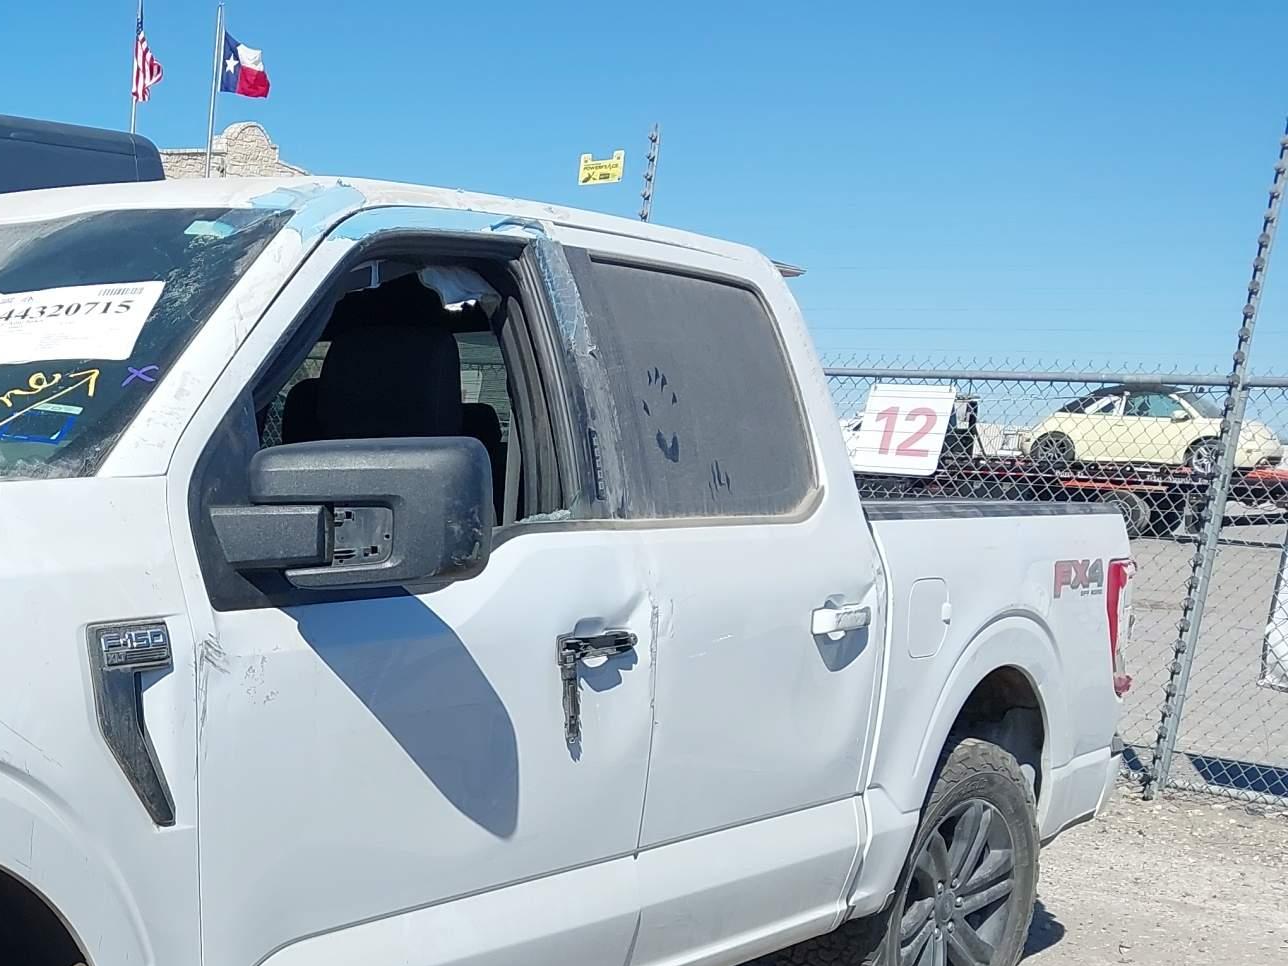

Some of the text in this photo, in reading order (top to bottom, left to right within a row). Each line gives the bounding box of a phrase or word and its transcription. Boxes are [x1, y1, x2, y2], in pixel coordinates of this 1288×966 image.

[875, 406, 938, 458] 12
[1053, 558, 1104, 600] FX4
[100, 628, 168, 652] F-150
